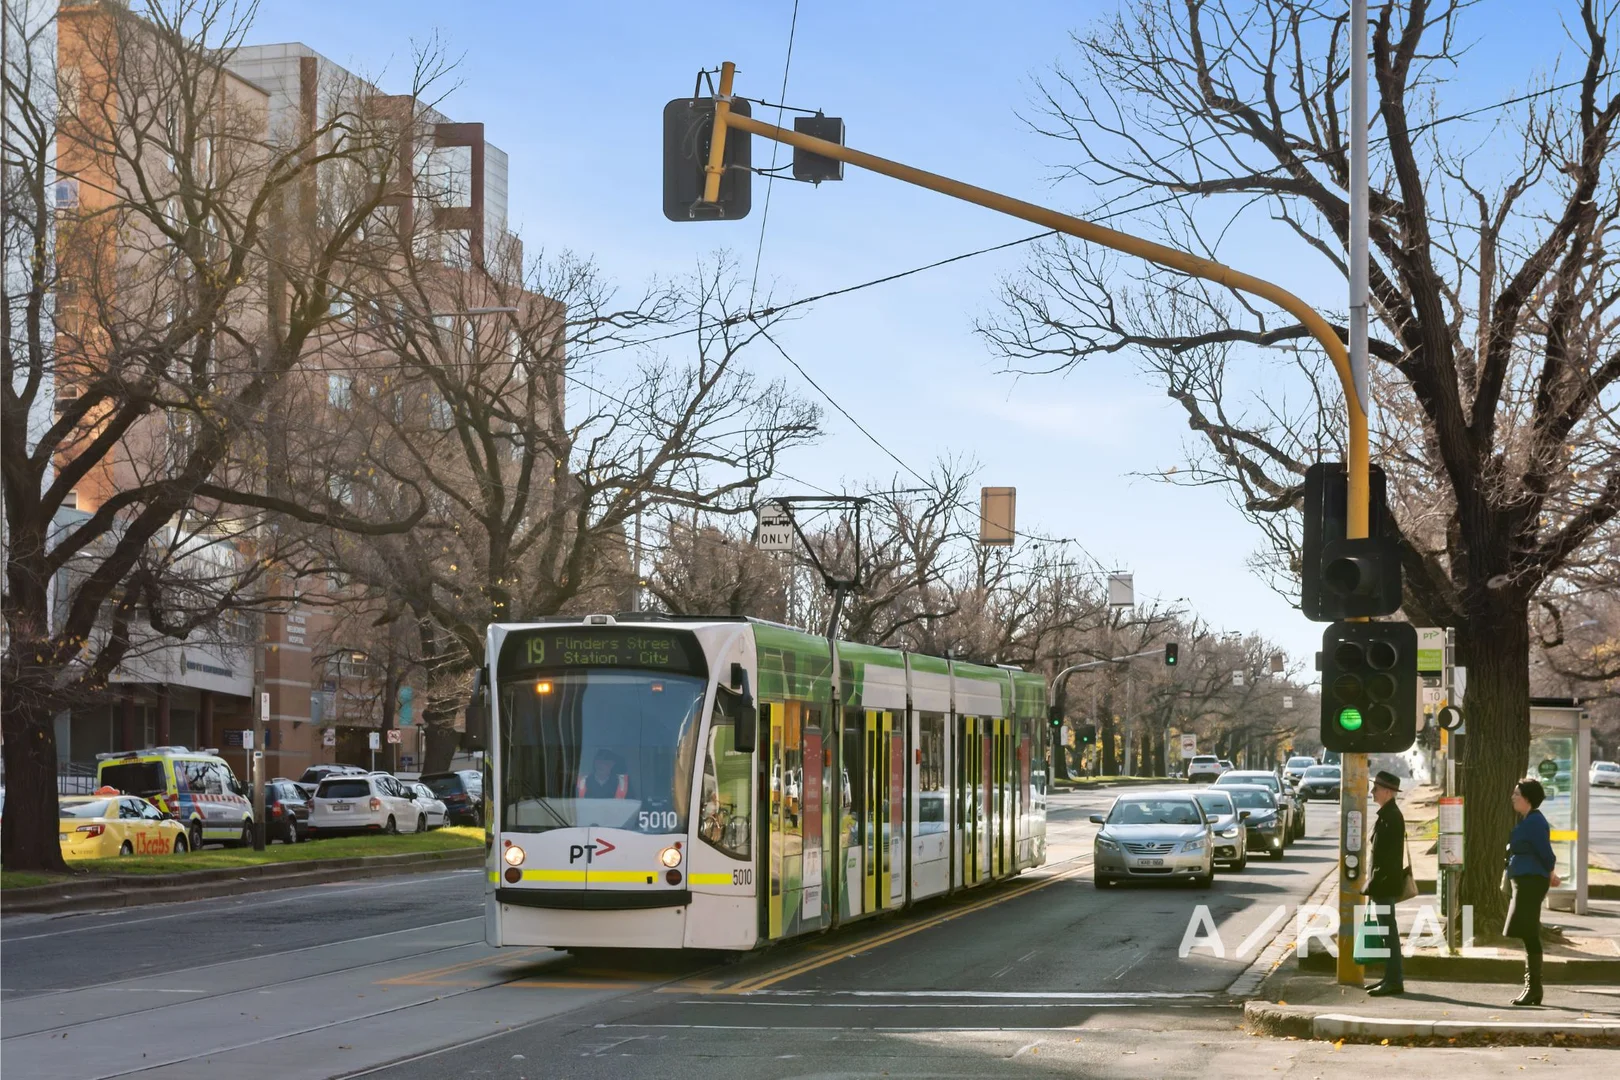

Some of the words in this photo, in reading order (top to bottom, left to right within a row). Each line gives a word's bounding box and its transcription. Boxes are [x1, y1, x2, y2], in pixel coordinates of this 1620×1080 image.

[761, 533, 790, 544] ONLY
[525, 637, 545, 665] 19
[556, 636, 619, 650] Flinders
[627, 636, 677, 650] Street
[563, 651, 618, 665] Station
[639, 651, 669, 665] City
[1429, 691, 1441, 701] 10
[638, 811, 678, 829] 5010
[136, 830, 170, 856] 13cabs
[733, 868, 752, 886] 5010
